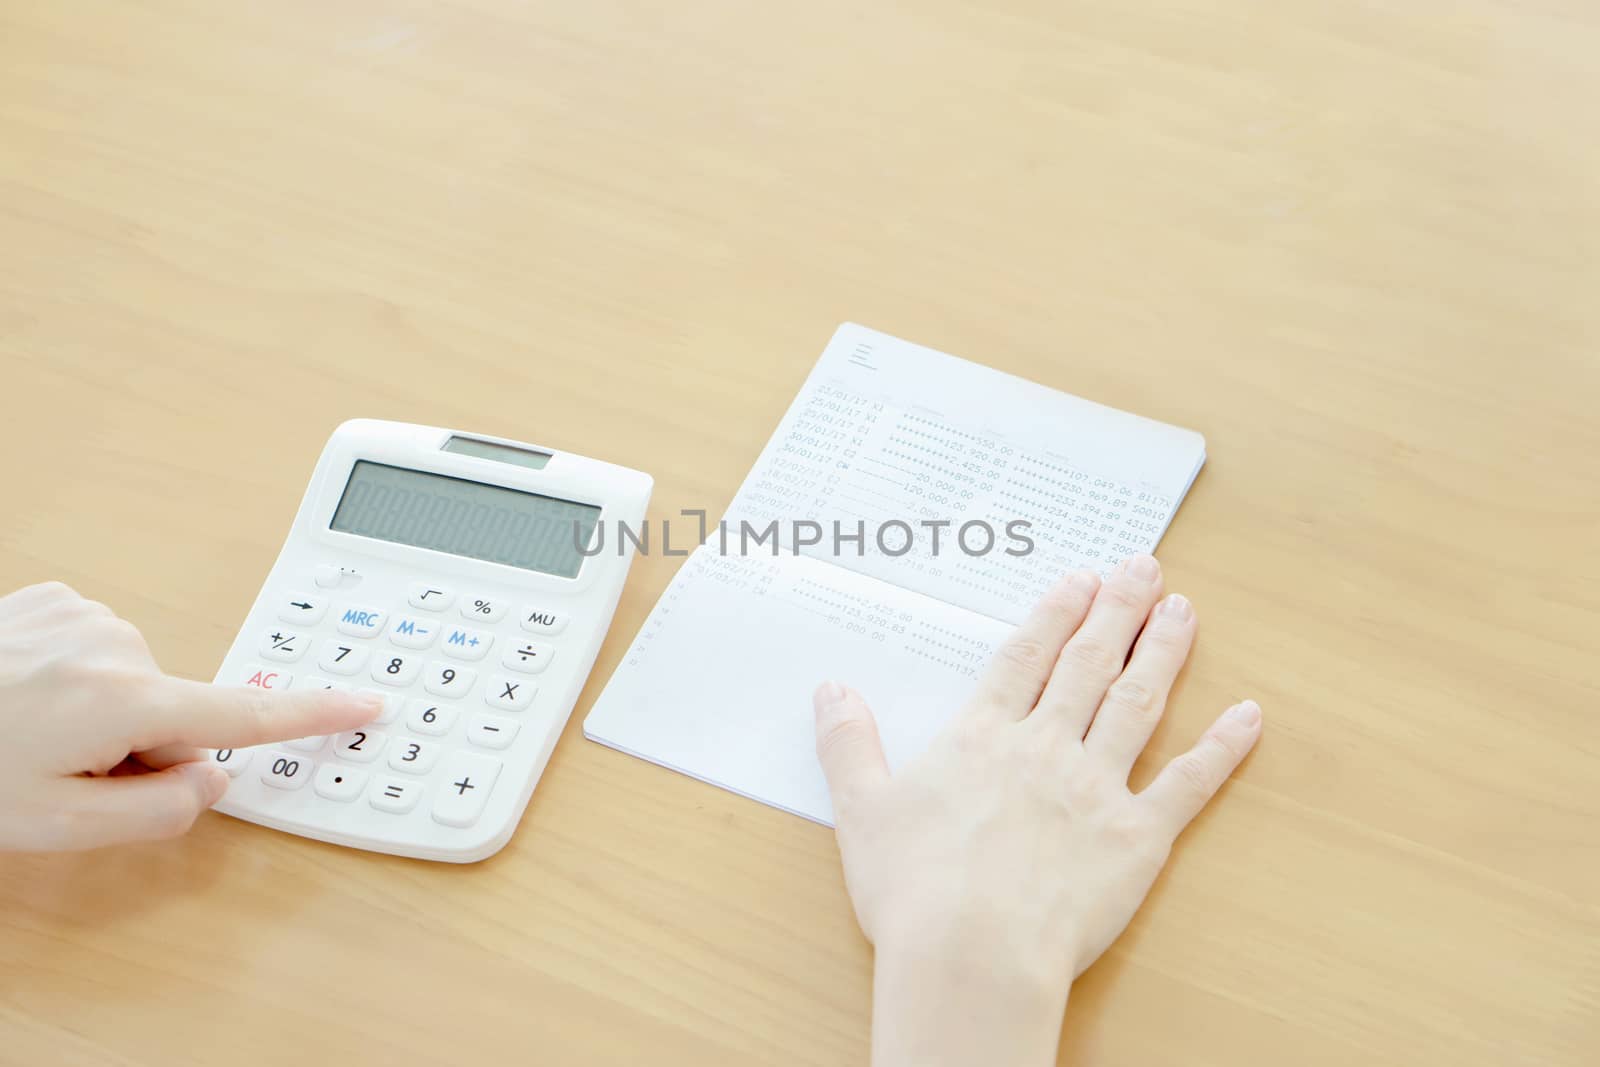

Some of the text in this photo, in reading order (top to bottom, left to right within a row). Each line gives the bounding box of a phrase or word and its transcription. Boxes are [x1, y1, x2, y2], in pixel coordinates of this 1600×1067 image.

[342, 610, 378, 627] MRC
[529, 613, 555, 625] MU
[448, 631, 479, 646] M+
[336, 647, 351, 661] 7
[387, 659, 402, 673] 8
[248, 672, 277, 688] AC
[442, 670, 455, 684] 9
[423, 708, 436, 722] 6
[348, 732, 366, 750] 2
[216, 748, 233, 762] 0
[403, 744, 420, 761] 3
[272, 758, 299, 777] 00
